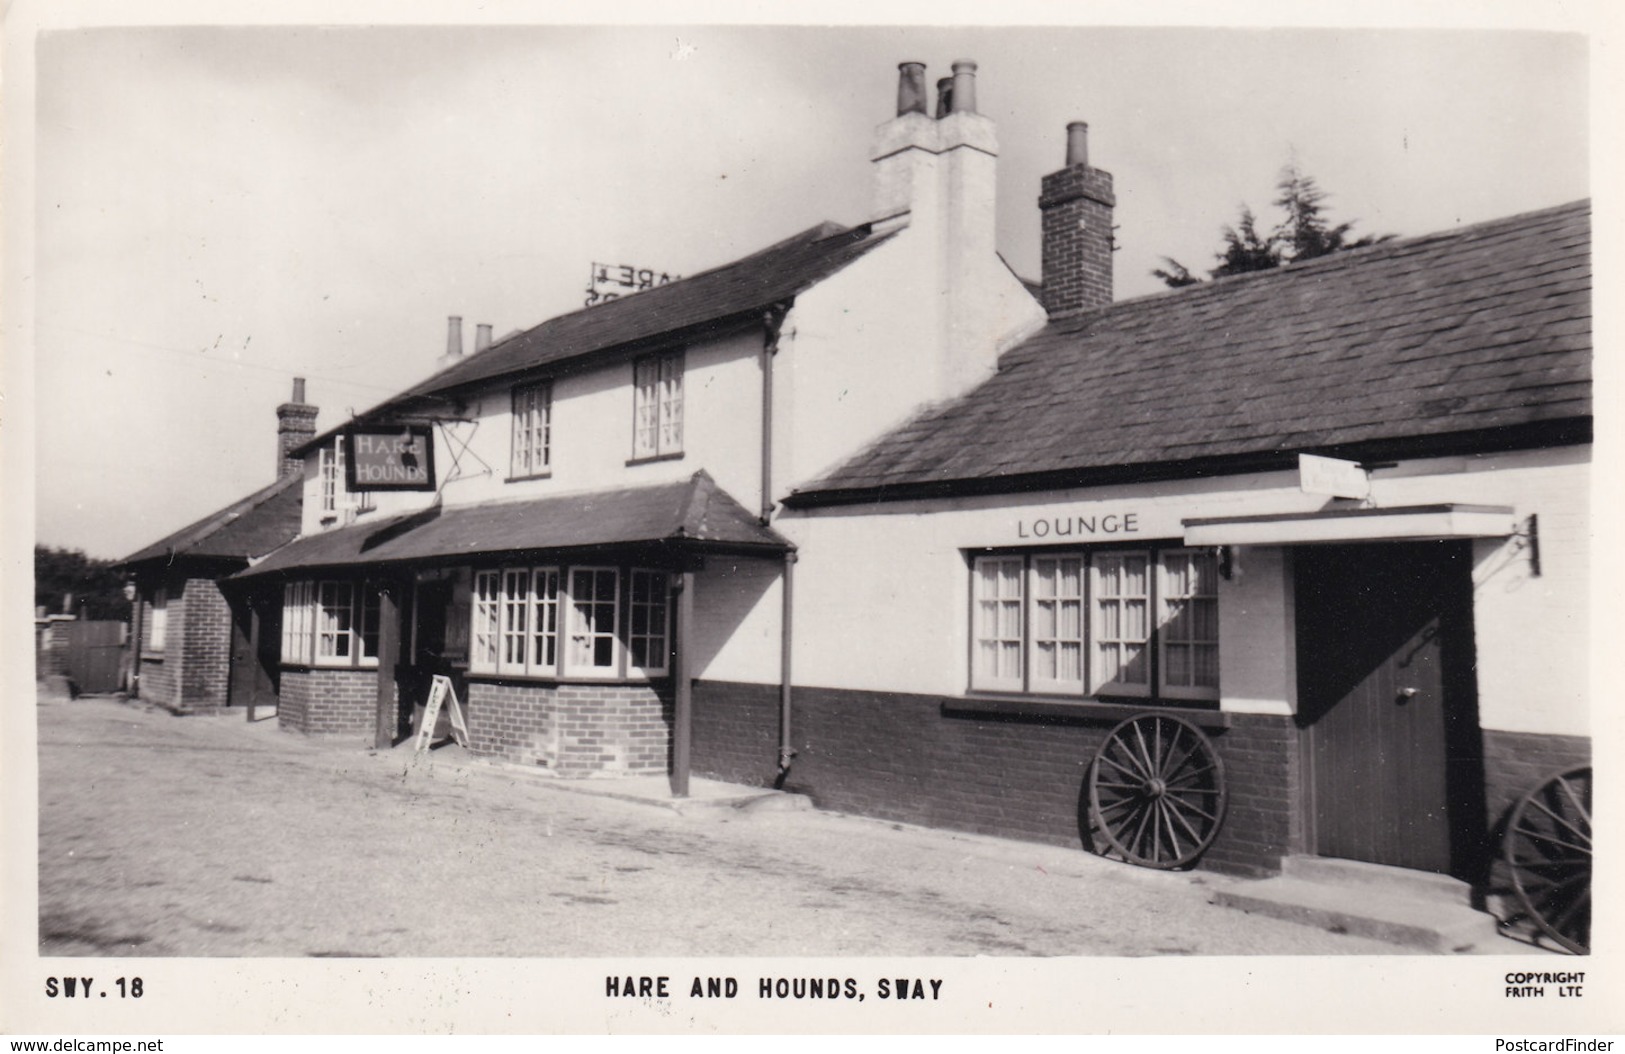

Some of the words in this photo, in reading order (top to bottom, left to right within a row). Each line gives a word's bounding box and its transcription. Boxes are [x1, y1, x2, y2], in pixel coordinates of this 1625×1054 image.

[357, 435, 422, 454] HARE
[385, 454, 396, 465] &
[356, 464, 427, 482] HOUNDS
[1017, 512, 1140, 539] LOUNGE
